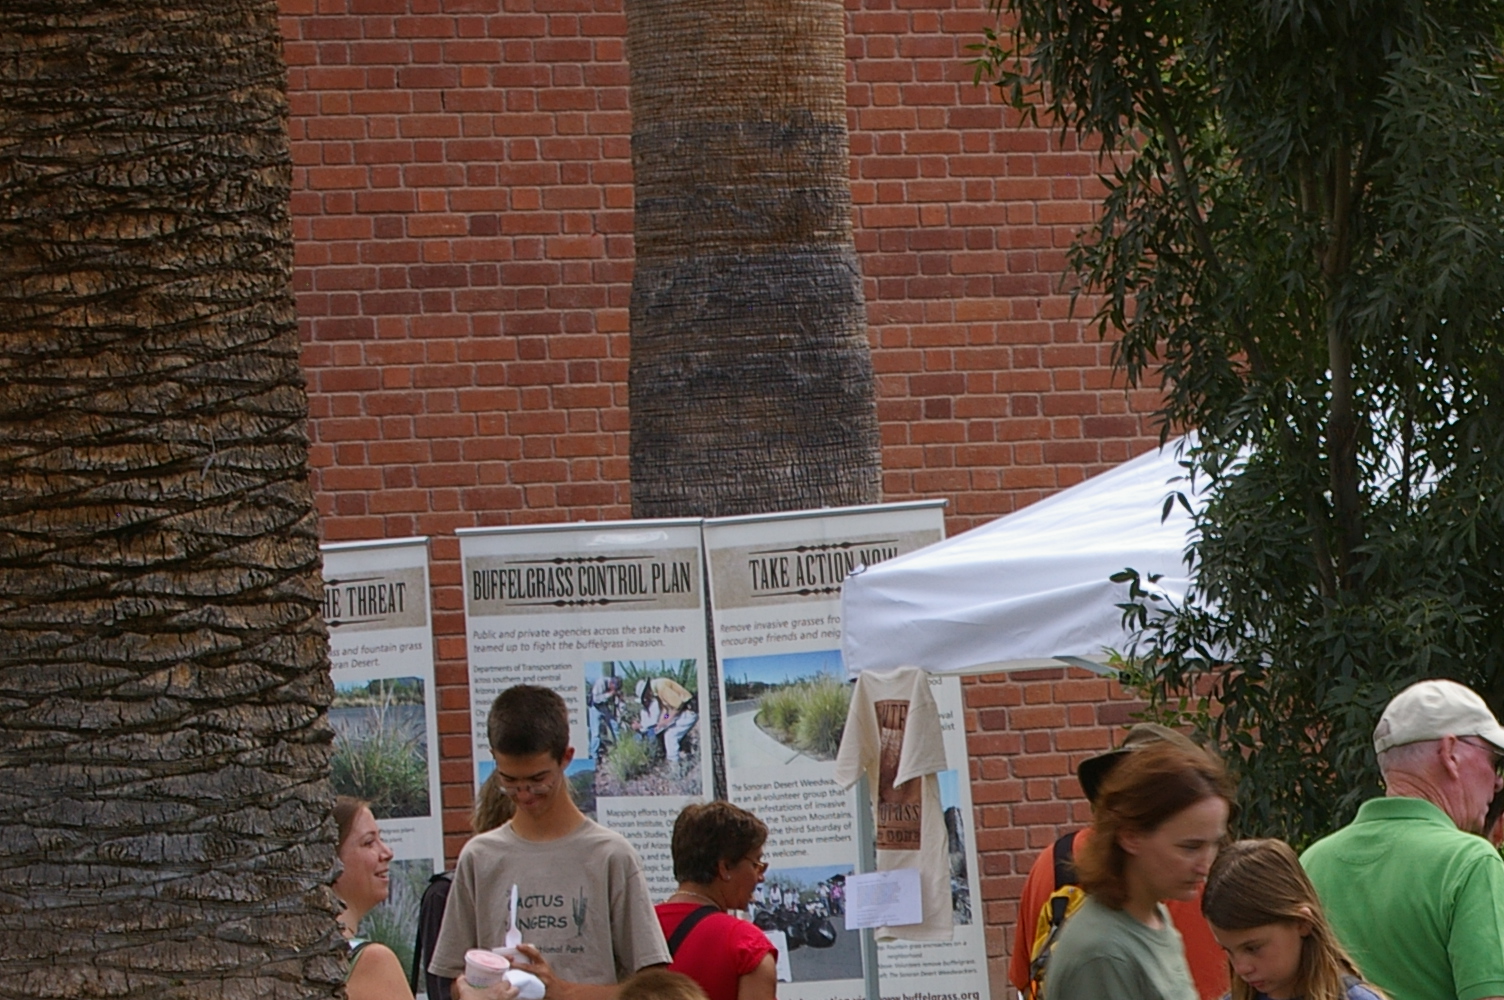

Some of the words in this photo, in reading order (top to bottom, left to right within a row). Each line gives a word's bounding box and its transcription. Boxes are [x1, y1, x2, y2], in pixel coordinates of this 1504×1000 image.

[749, 557, 790, 590] TAKE
[796, 551, 855, 587] ACTION
[472, 567, 574, 600] BUFFELGRASS
[578, 564, 647, 597] CONTROL
[652, 562, 691, 594] PLAN
[346, 582, 406, 617] THREAT
[473, 630, 497, 640] Public
[499, 629, 516, 639] and
[517, 628, 551, 640] private
[553, 627, 591, 639] agencies
[594, 626, 619, 635] across
[622, 625, 637, 635] the
[639, 624, 661, 634] state
[663, 624, 686, 634] have
[720, 623, 752, 633] Remove
[753, 619, 788, 631] invasive
[791, 617, 824, 629] grasses
[721, 635, 764, 647] encourage
[766, 631, 798, 643] friends
[800, 630, 819, 640] and
[342, 645, 359, 656] and
[361, 642, 398, 654] fountain
[400, 642, 423, 654] grass
[473, 643, 505, 653] teamed
[506, 643, 518, 654] up
[520, 642, 531, 651] to
[533, 641, 557, 652] fight
[557, 640, 574, 650] the
[576, 638, 624, 650] buffelgrass
[626, 638, 665, 648] invasion.
[473, 664, 513, 673] Departments
[522, 663, 572, 672] Transportation
[774, 780, 798, 790] Desert
[803, 790, 828, 800] group
[606, 809, 637, 818] Mapping
[758, 803, 802, 813] infestations
[804, 801, 813, 809] of
[815, 800, 846, 809] invasive
[781, 814, 808, 823] Tucson
[785, 825, 805, 834] third
[806, 823, 841, 834] Saturday
[843, 822, 852, 831] of
[780, 837, 795, 846] and
[508, 894, 564, 912] ACTUS
